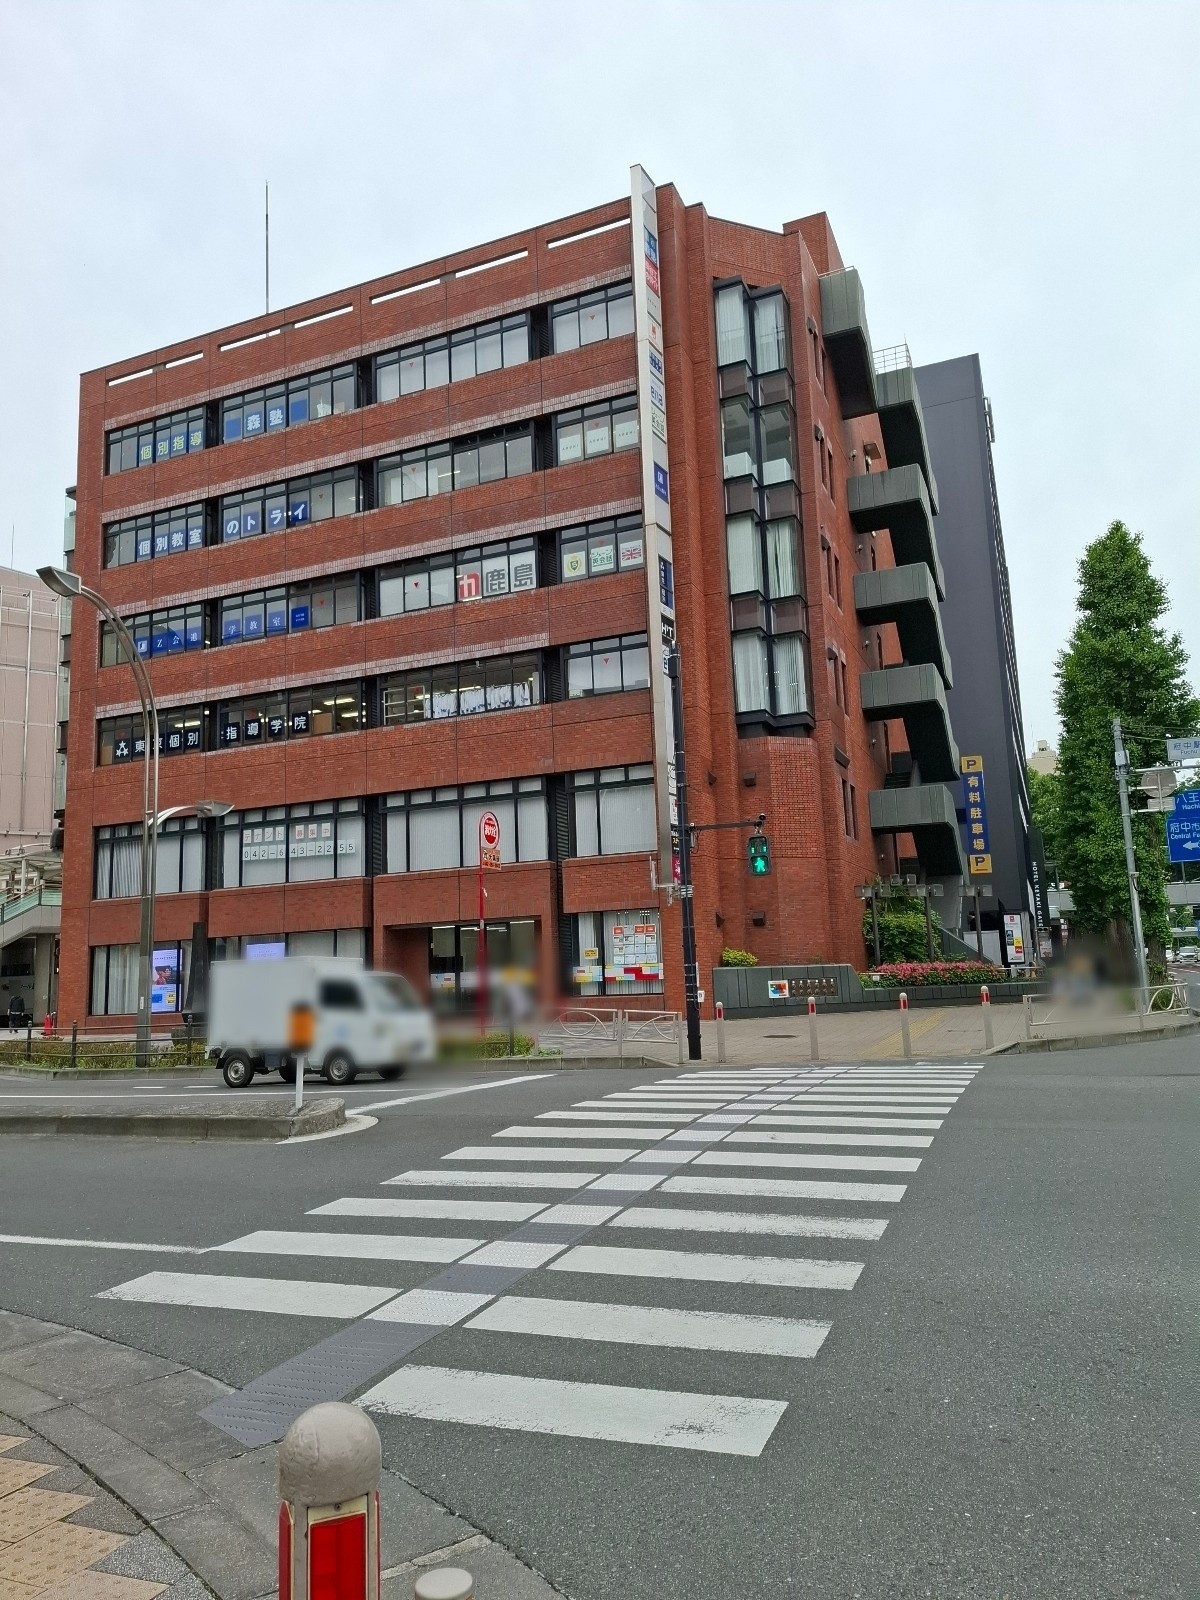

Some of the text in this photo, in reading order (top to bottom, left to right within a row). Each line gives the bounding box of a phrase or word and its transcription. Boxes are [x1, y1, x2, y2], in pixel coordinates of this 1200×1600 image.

[140, 409, 283, 460] 個別指導 森塾
[486, 564, 533, 593] 鹿島
[966, 759, 977, 770] P
[968, 776, 985, 851] 有料駐車場
[244, 828, 329, 839] テナント 募集中
[1170, 832, 1191, 840] Central
[244, 843, 354, 859] 042-643-2255
[974, 856, 986, 867] P
[1034, 884, 1042, 908] KEYAKI
